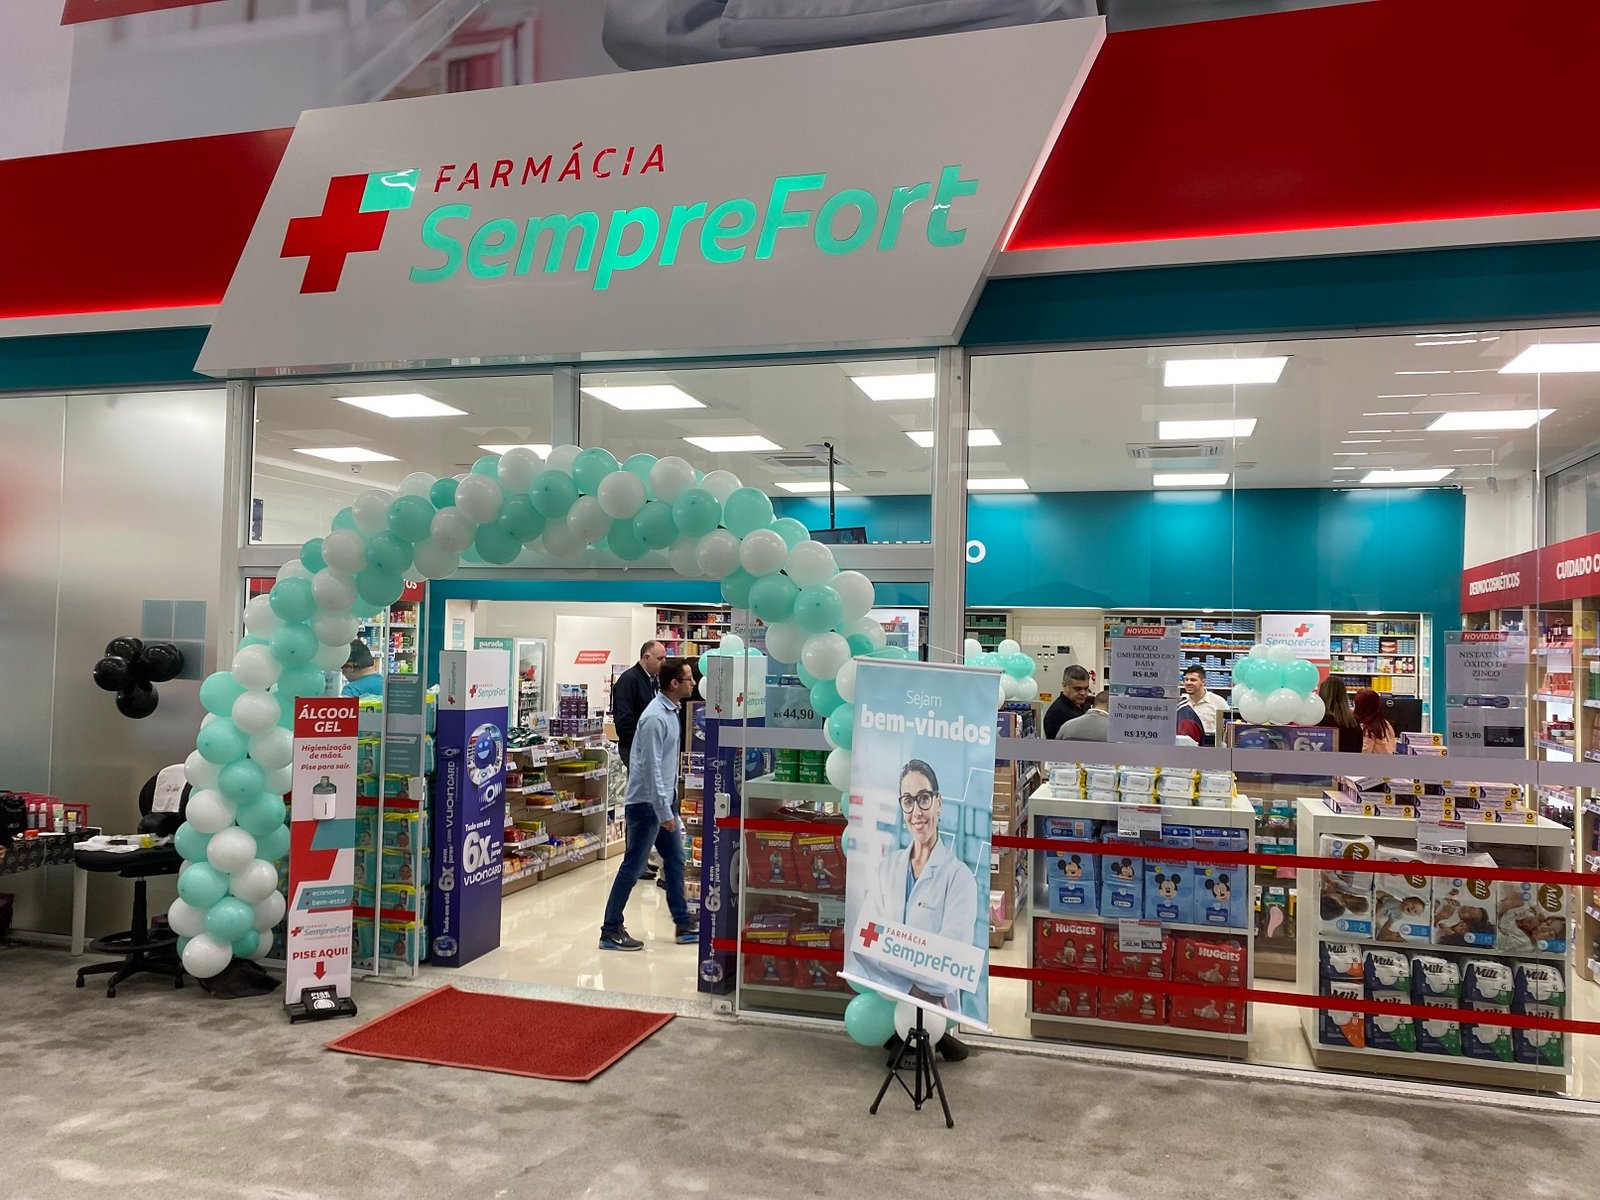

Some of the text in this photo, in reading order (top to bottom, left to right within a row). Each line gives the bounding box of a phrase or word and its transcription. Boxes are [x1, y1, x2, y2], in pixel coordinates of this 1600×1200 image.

[433, 141, 667, 194] FARMÁCIA
[408, 165, 979, 291] SempreFort
[1556, 555, 1592, 580] CUIDADO
[1469, 571, 1520, 596] DERMOCOSMÉTICOS
[1127, 627, 1163, 635] NOVIDADE
[1464, 632, 1506, 641] NOVIDADE
[1133, 644, 1158, 653] LENÇO
[1116, 651, 1160, 660] UMEDECIDO
[1459, 650, 1506, 659] NISTATINA
[1464, 660, 1494, 668] ÓXIDO
[1132, 670, 1142, 678] R$
[1472, 669, 1500, 678] ZINCO
[906, 689, 942, 709] Sejam
[298, 704, 357, 720] ÁLCOOL
[1128, 704, 1153, 712] compra
[783, 708, 814, 720] 44,90
[314, 721, 342, 733] GEL
[861, 703, 991, 746] bem-vindos
[1136, 731, 1158, 739] 19,90
[301, 743, 352, 752] Higienização
[465, 822, 476, 832] Tudo
[476, 821, 484, 830] em
[312, 888, 345, 896] economia
[312, 897, 347, 906] bem-estar
[303, 925, 351, 936] SempreFort
[1055, 923, 1097, 936] HUGGIES
[886, 927, 927, 946] FARMÁCIA
[292, 946, 349, 960] PISE AQUI!
[1199, 947, 1240, 962] HUGGIES
[1327, 944, 1348, 954] Mili
[882, 936, 976, 983] SempreFort
[1374, 954, 1394, 966] Mili
[1423, 963, 1444, 974] Mili
[1476, 966, 1498, 979] Mili
[1526, 969, 1549, 980] Mili
